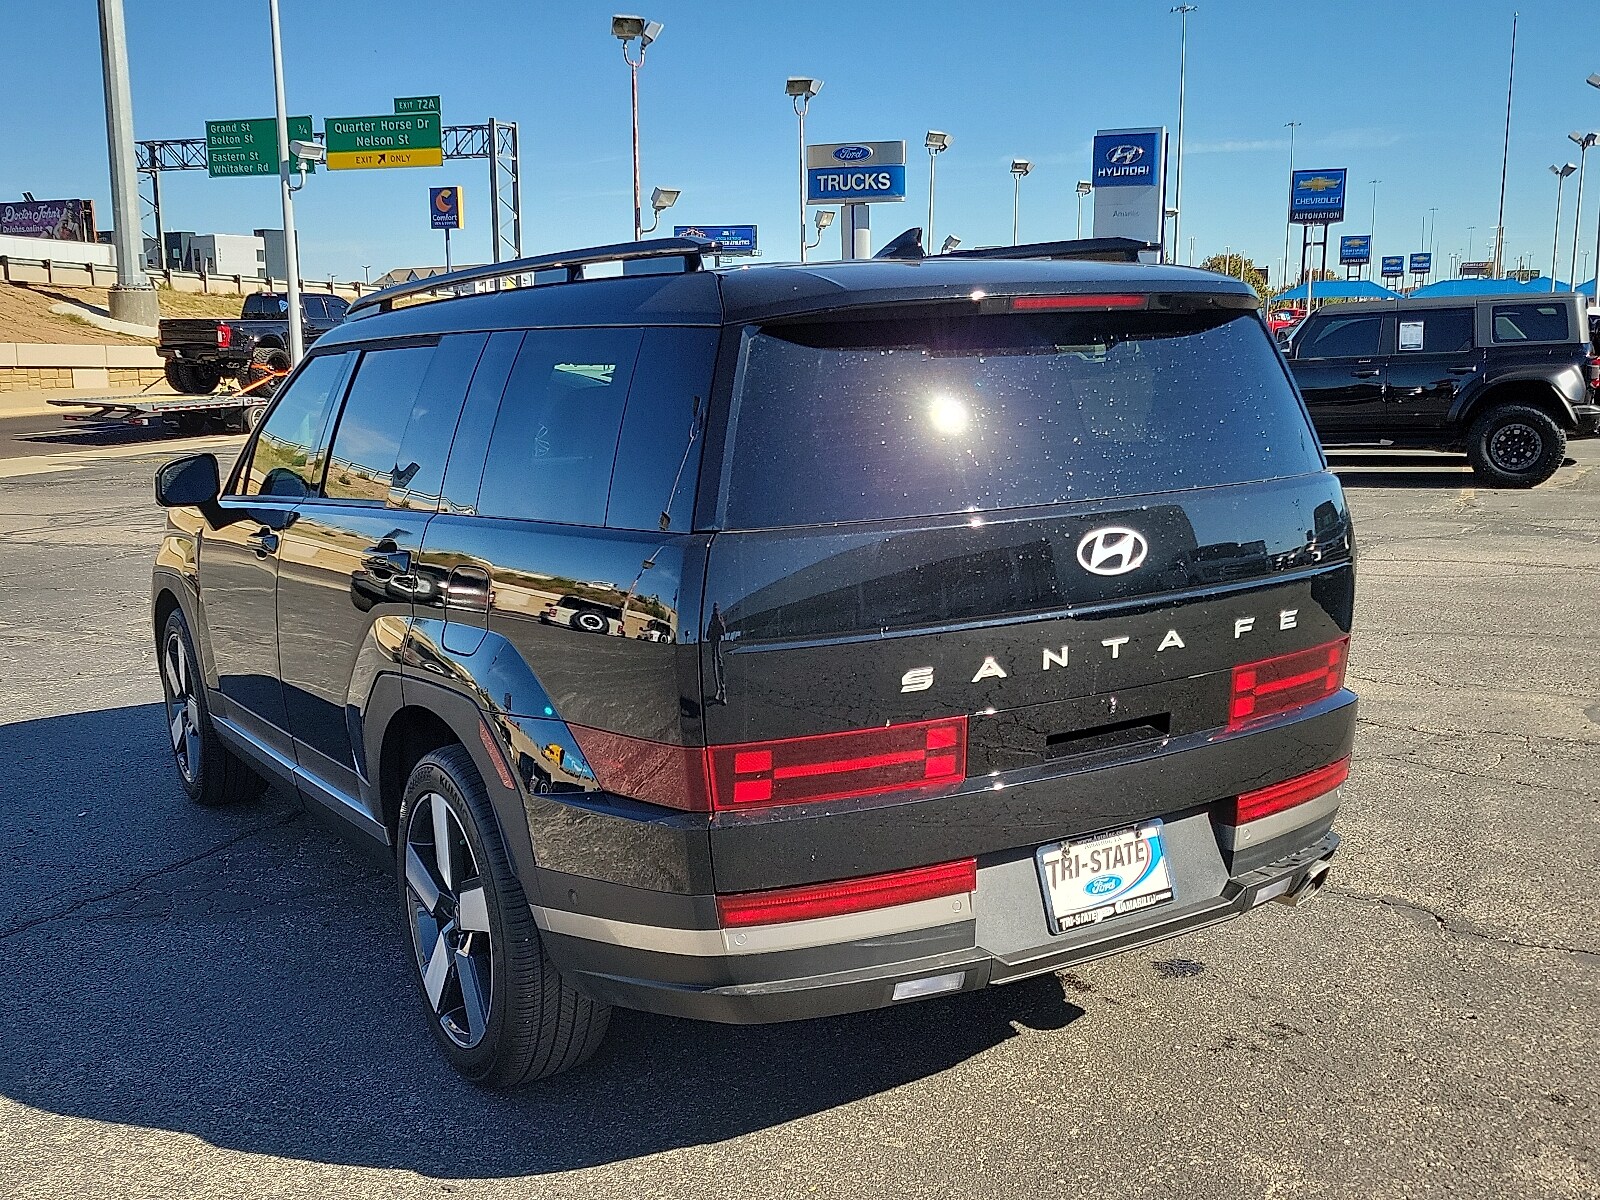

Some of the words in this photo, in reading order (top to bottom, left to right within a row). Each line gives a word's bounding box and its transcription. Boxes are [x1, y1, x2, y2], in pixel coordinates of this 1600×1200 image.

[399, 102, 413, 110] EXIT
[417, 99, 435, 110] 72A
[210, 124, 237, 133] Grand
[241, 123, 251, 132] St
[334, 122, 376, 134] Quarter
[381, 120, 412, 131] Horse
[417, 118, 430, 129] Dr
[211, 135, 240, 145] Bolton
[244, 134, 254, 144] St
[356, 135, 394, 147] Nelson
[398, 133, 410, 145] St
[212, 153, 246, 162] Eastern
[249, 151, 260, 161] St
[839, 147, 863, 159] Ford
[355, 156, 373, 164] EXIT
[390, 155, 411, 163] ONLY
[213, 164, 254, 174] Whitaker
[257, 163, 269, 173] Rd
[1097, 165, 1150, 177] HYUNDAI
[816, 172, 891, 192] TRUCKS
[1295, 196, 1341, 205] CHEVROLET
[2, 205, 33, 223] Doctor
[432, 213, 458, 222] Comfort
[1294, 211, 1340, 220] AUTONATION
[900, 629, 1186, 693] SANTA
[1233, 608, 1299, 639] FE
[1045, 840, 1145, 891] TRI-STATE
[1091, 876, 1116, 894] Ford
[1060, 909, 1097, 931] TRI-STATE
